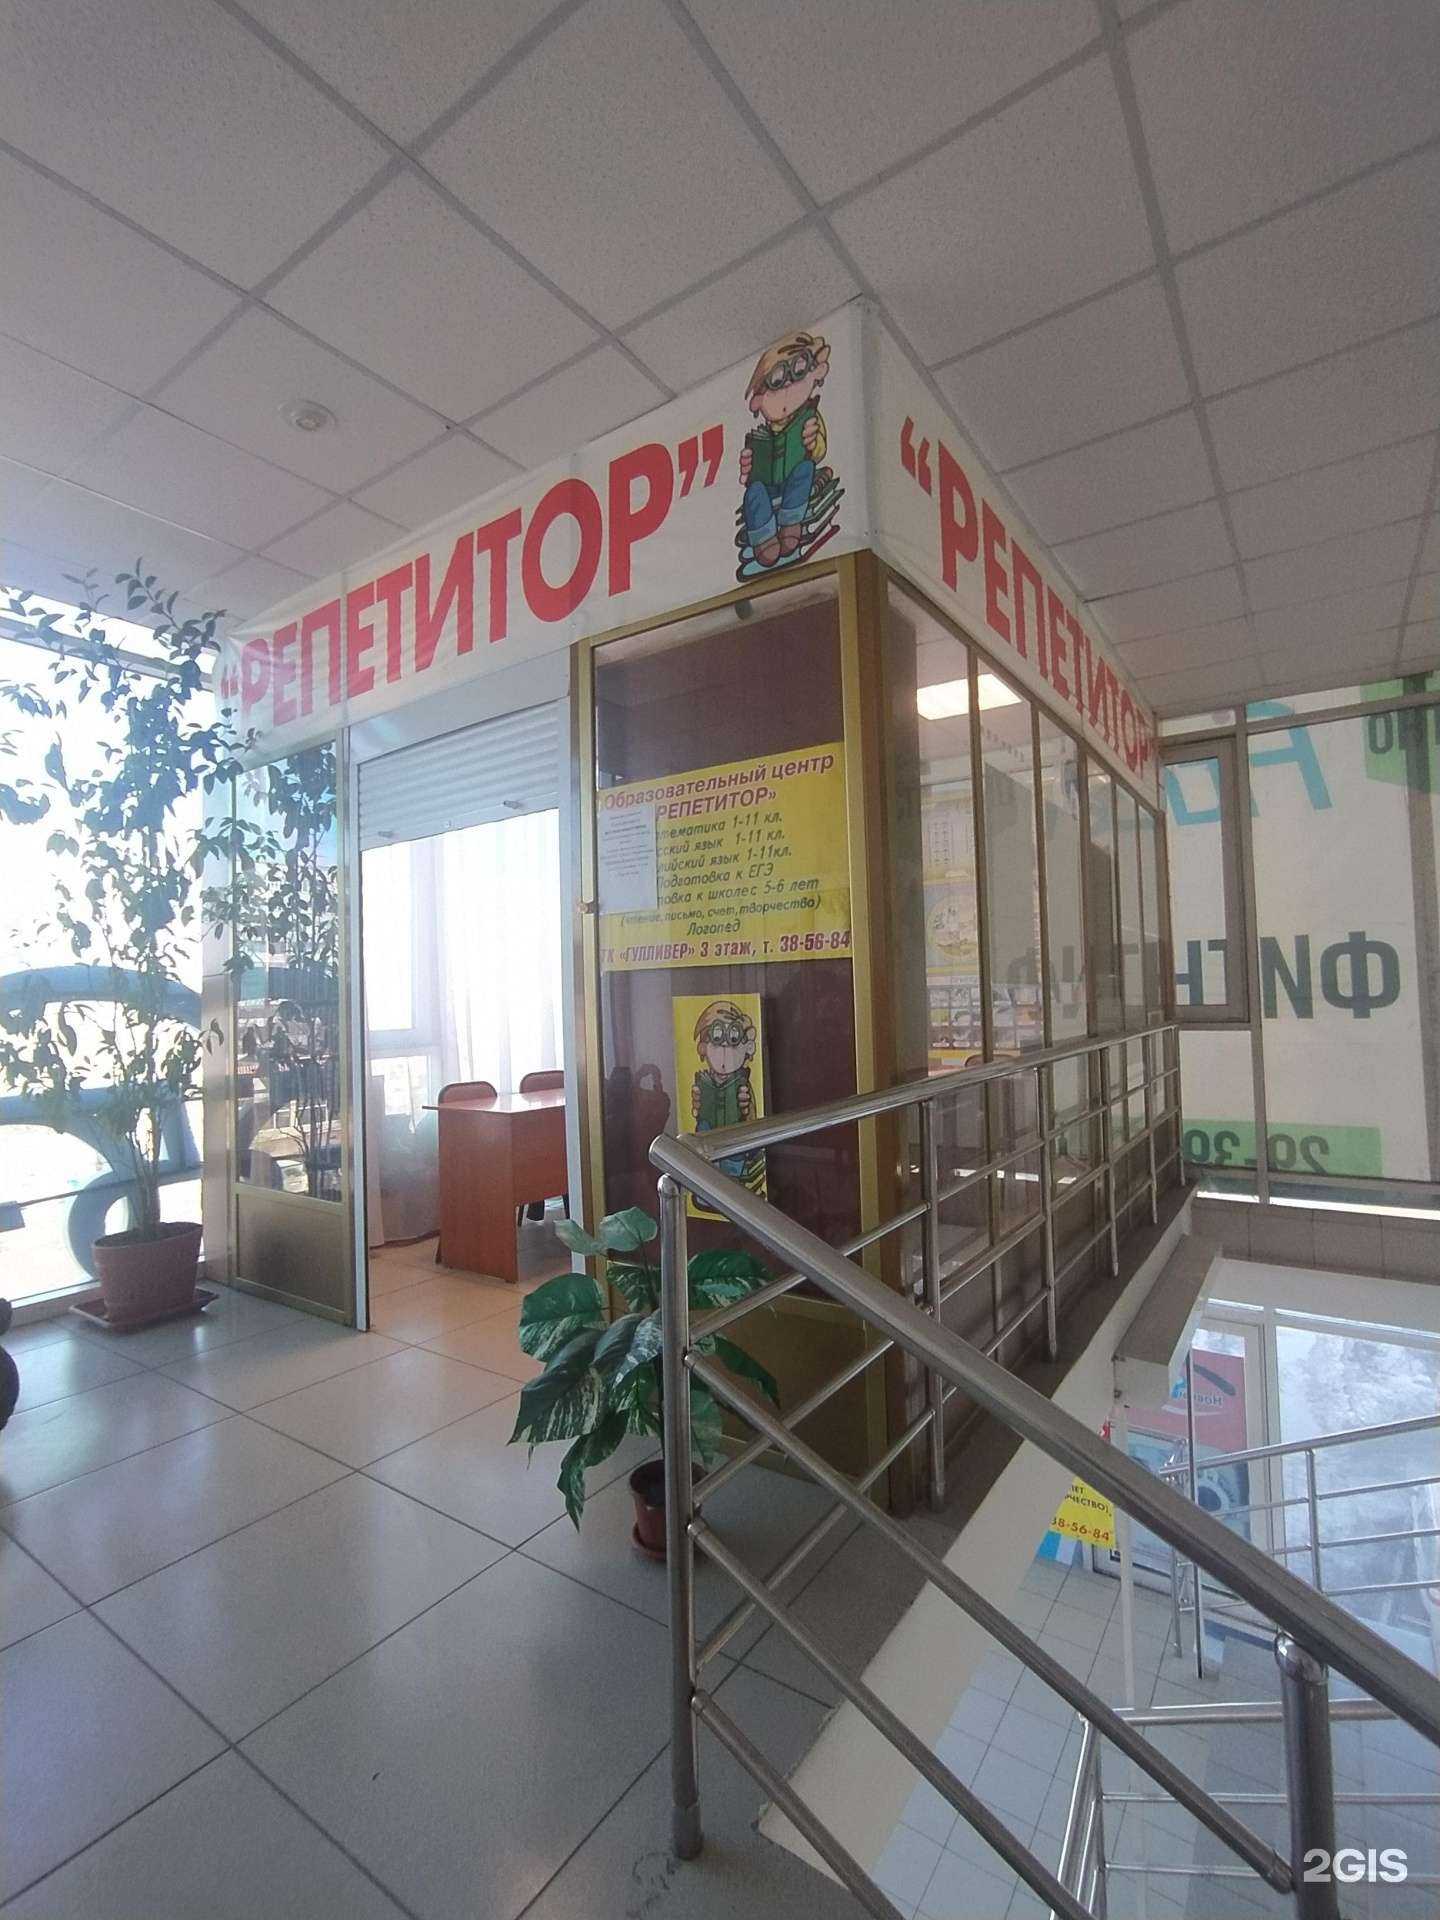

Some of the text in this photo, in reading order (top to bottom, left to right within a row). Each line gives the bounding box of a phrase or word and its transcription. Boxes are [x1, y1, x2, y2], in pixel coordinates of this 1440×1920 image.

[605, 755, 834, 809] Образовательный центр
[657, 812, 783, 839] тематика 1-11 кл.
[694, 838, 724, 852] язык
[736, 829, 762, 845] 1-11
[767, 830, 785, 841] кл.
[709, 853, 740, 866] язык
[735, 870, 743, 880] к
[748, 863, 774, 878] ЕГЭ
[696, 892, 704, 901] к
[764, 879, 784, 894] 5-6
[790, 878, 819, 891] лет
[665, 910, 705, 922] письмо,
[686, 919, 741, 936] Логопед
[700, 942, 709, 957] 3
[714, 942, 756, 957] этаж,
[780, 931, 850, 953] 38-56-84
